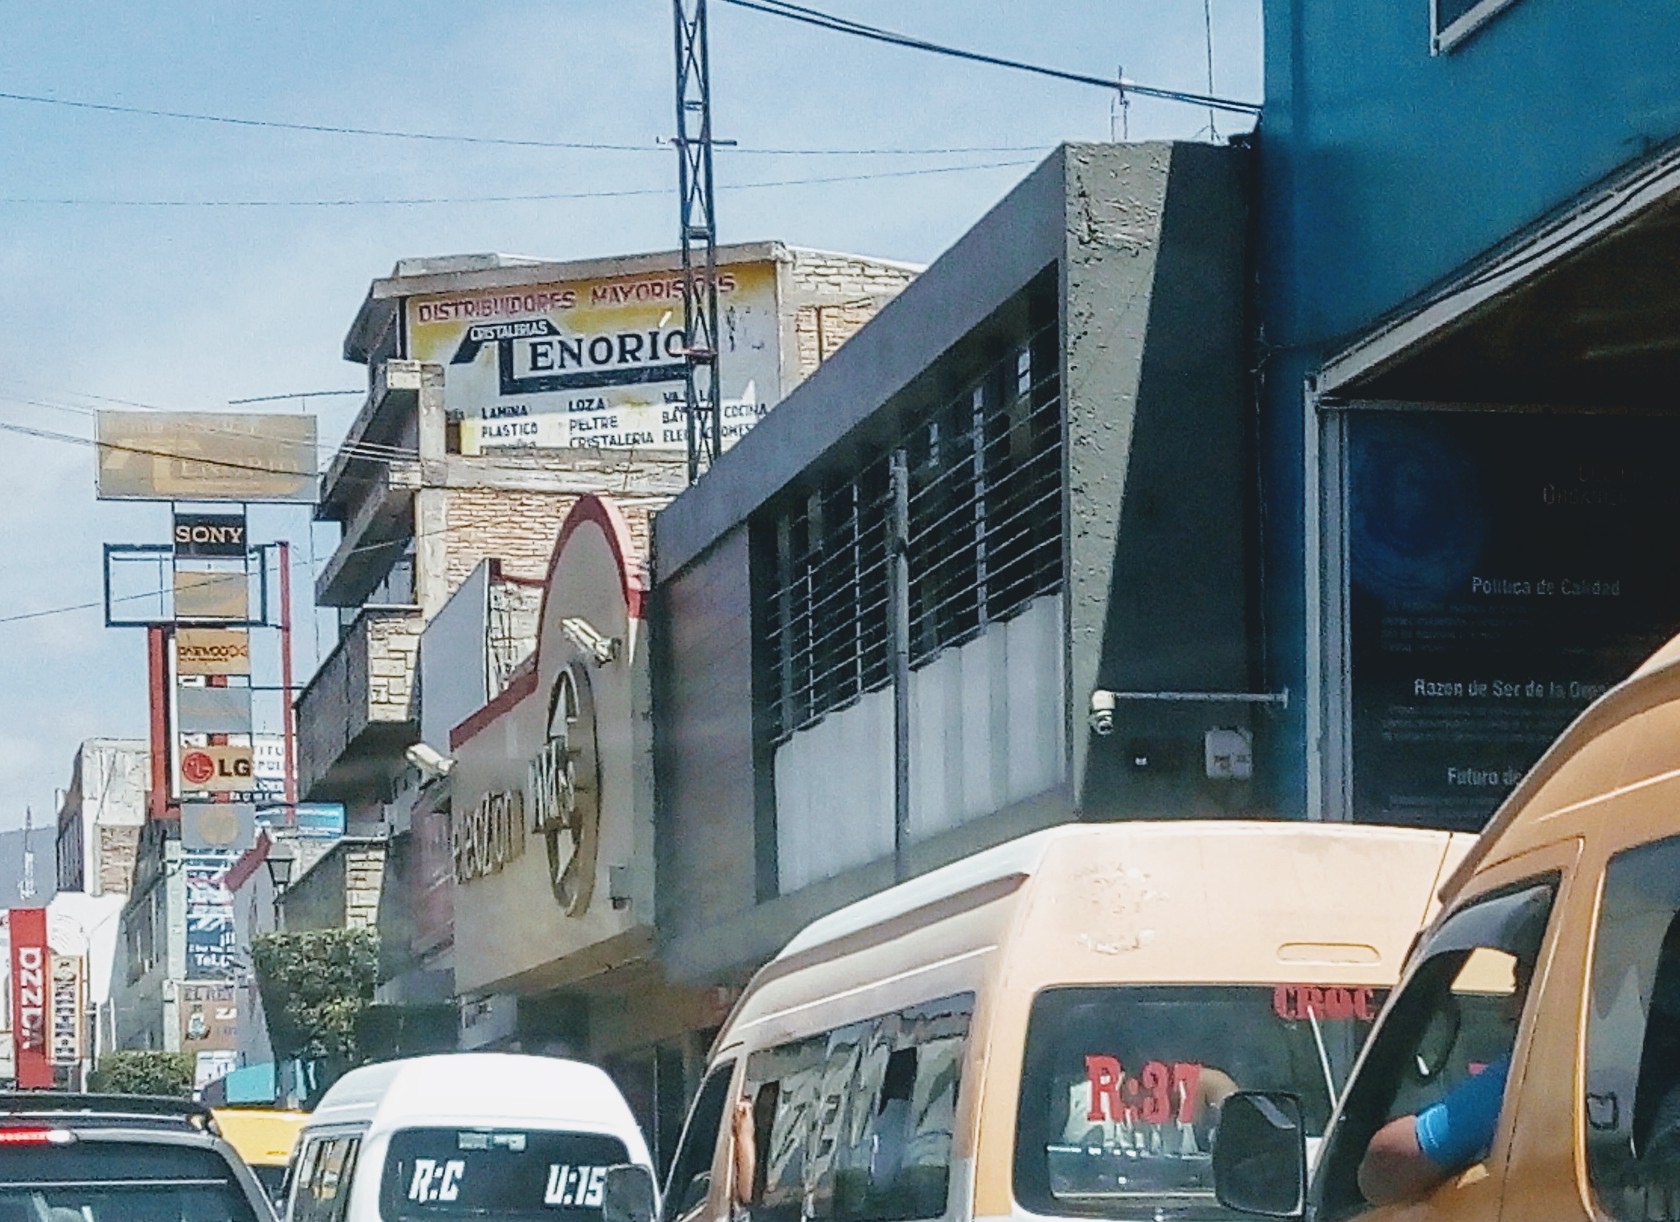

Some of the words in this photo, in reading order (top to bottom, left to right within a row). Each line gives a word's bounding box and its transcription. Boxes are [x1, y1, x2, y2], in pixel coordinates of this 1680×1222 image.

[591, 273, 736, 304] MAYORISS
[568, 397, 606, 412] LOZA
[569, 432, 655, 449] CRISTALERIA
[175, 525, 244, 544] SONY
[1468, 678, 1488, 698] de
[1492, 679, 1520, 698] Ser
[1525, 679, 1545, 698] de
[219, 758, 251, 777] LG
